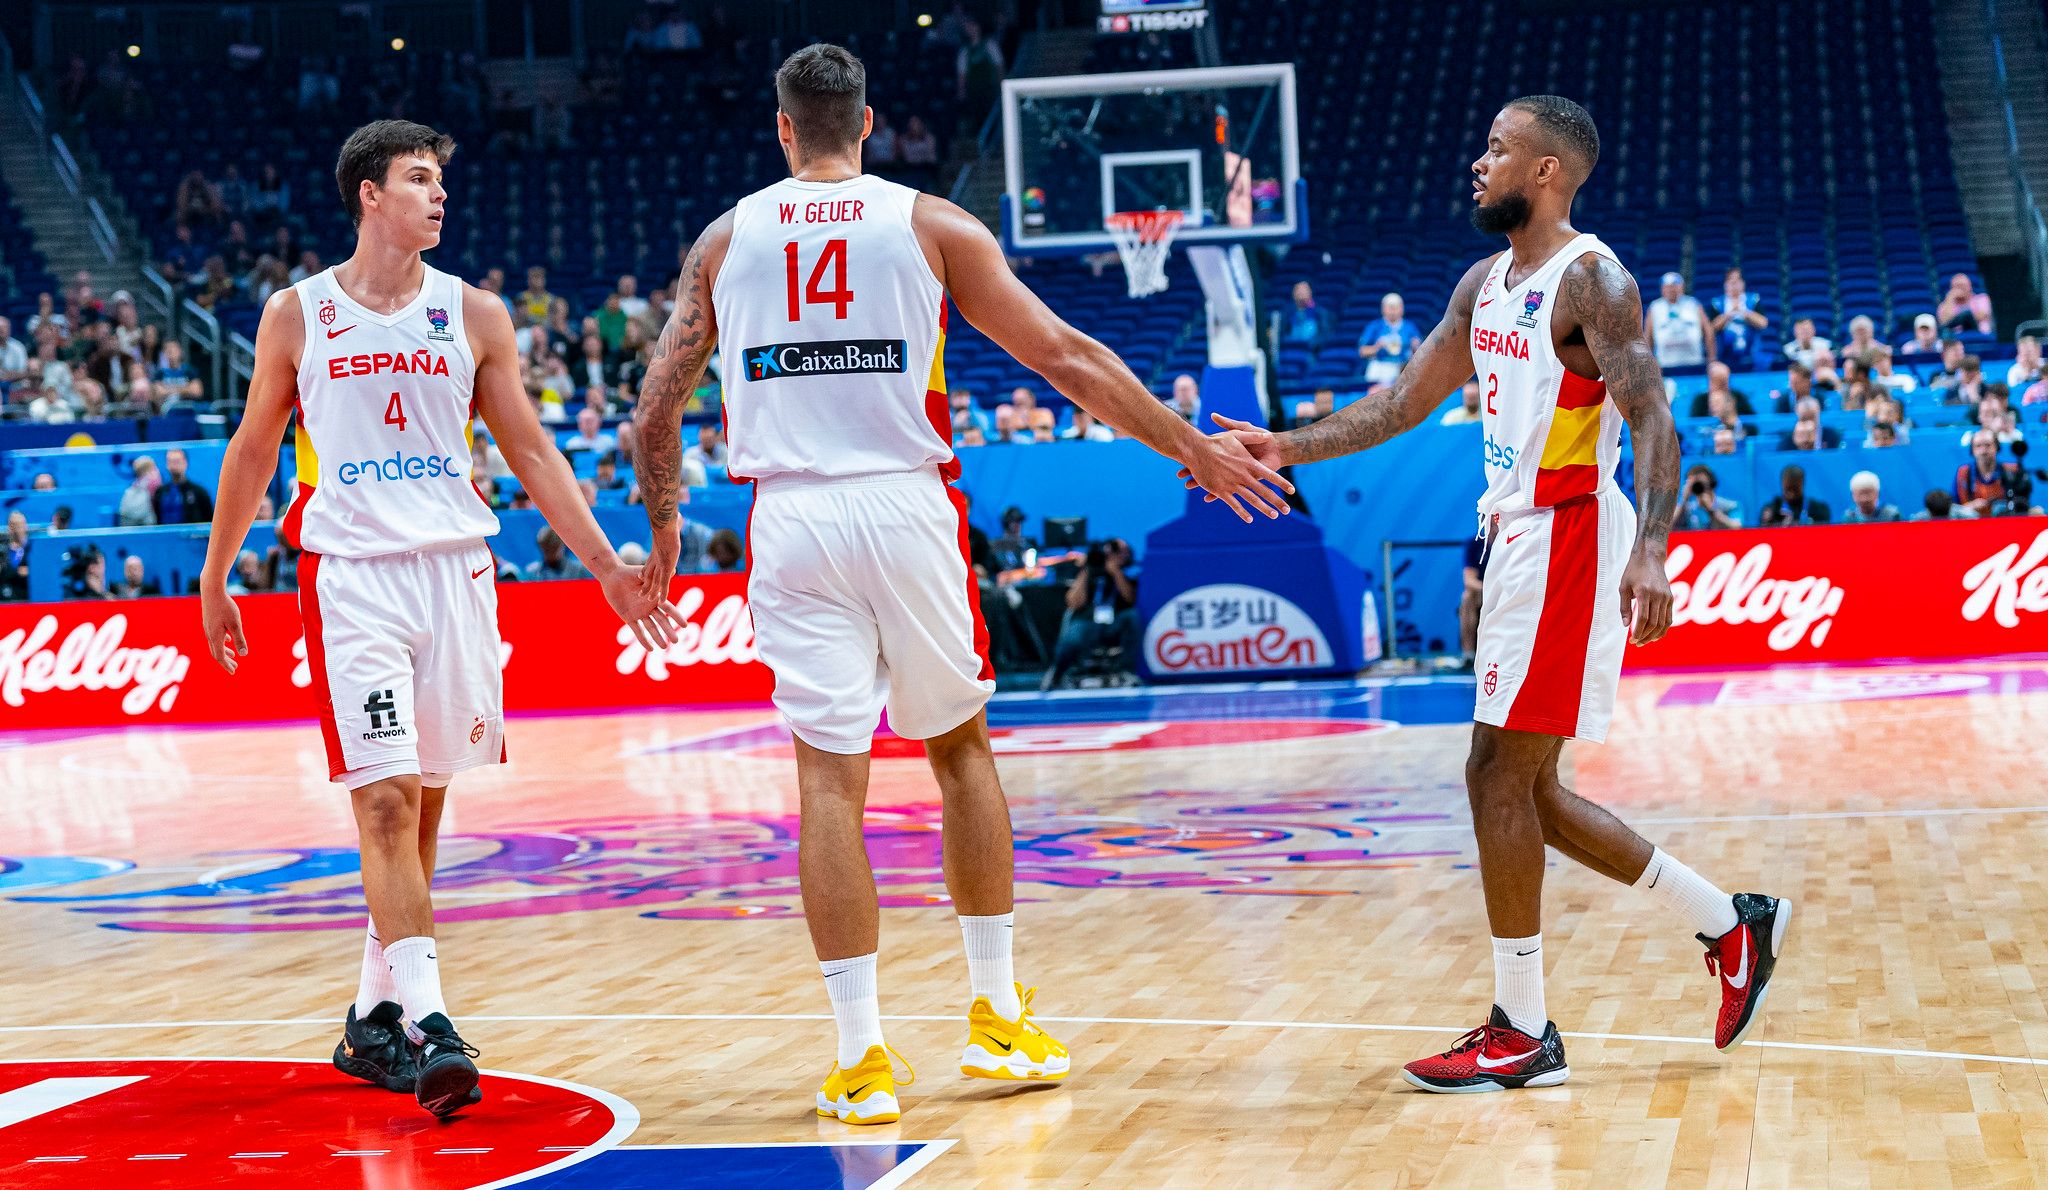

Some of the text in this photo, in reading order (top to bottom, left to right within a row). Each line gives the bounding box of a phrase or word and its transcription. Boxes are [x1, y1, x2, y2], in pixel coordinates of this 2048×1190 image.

[779, 200, 864, 224] W. GEUER
[783, 239, 854, 322] 14
[779, 345, 900, 372] CaixaBank
[1474, 328, 1530, 361] ESPAÑA
[328, 349, 450, 380] ESPAÑA
[1487, 373, 1498, 415] 2
[384, 392, 407, 431] 4
[1176, 599, 1278, 629] 百岁山
[363, 727, 407, 740] network
